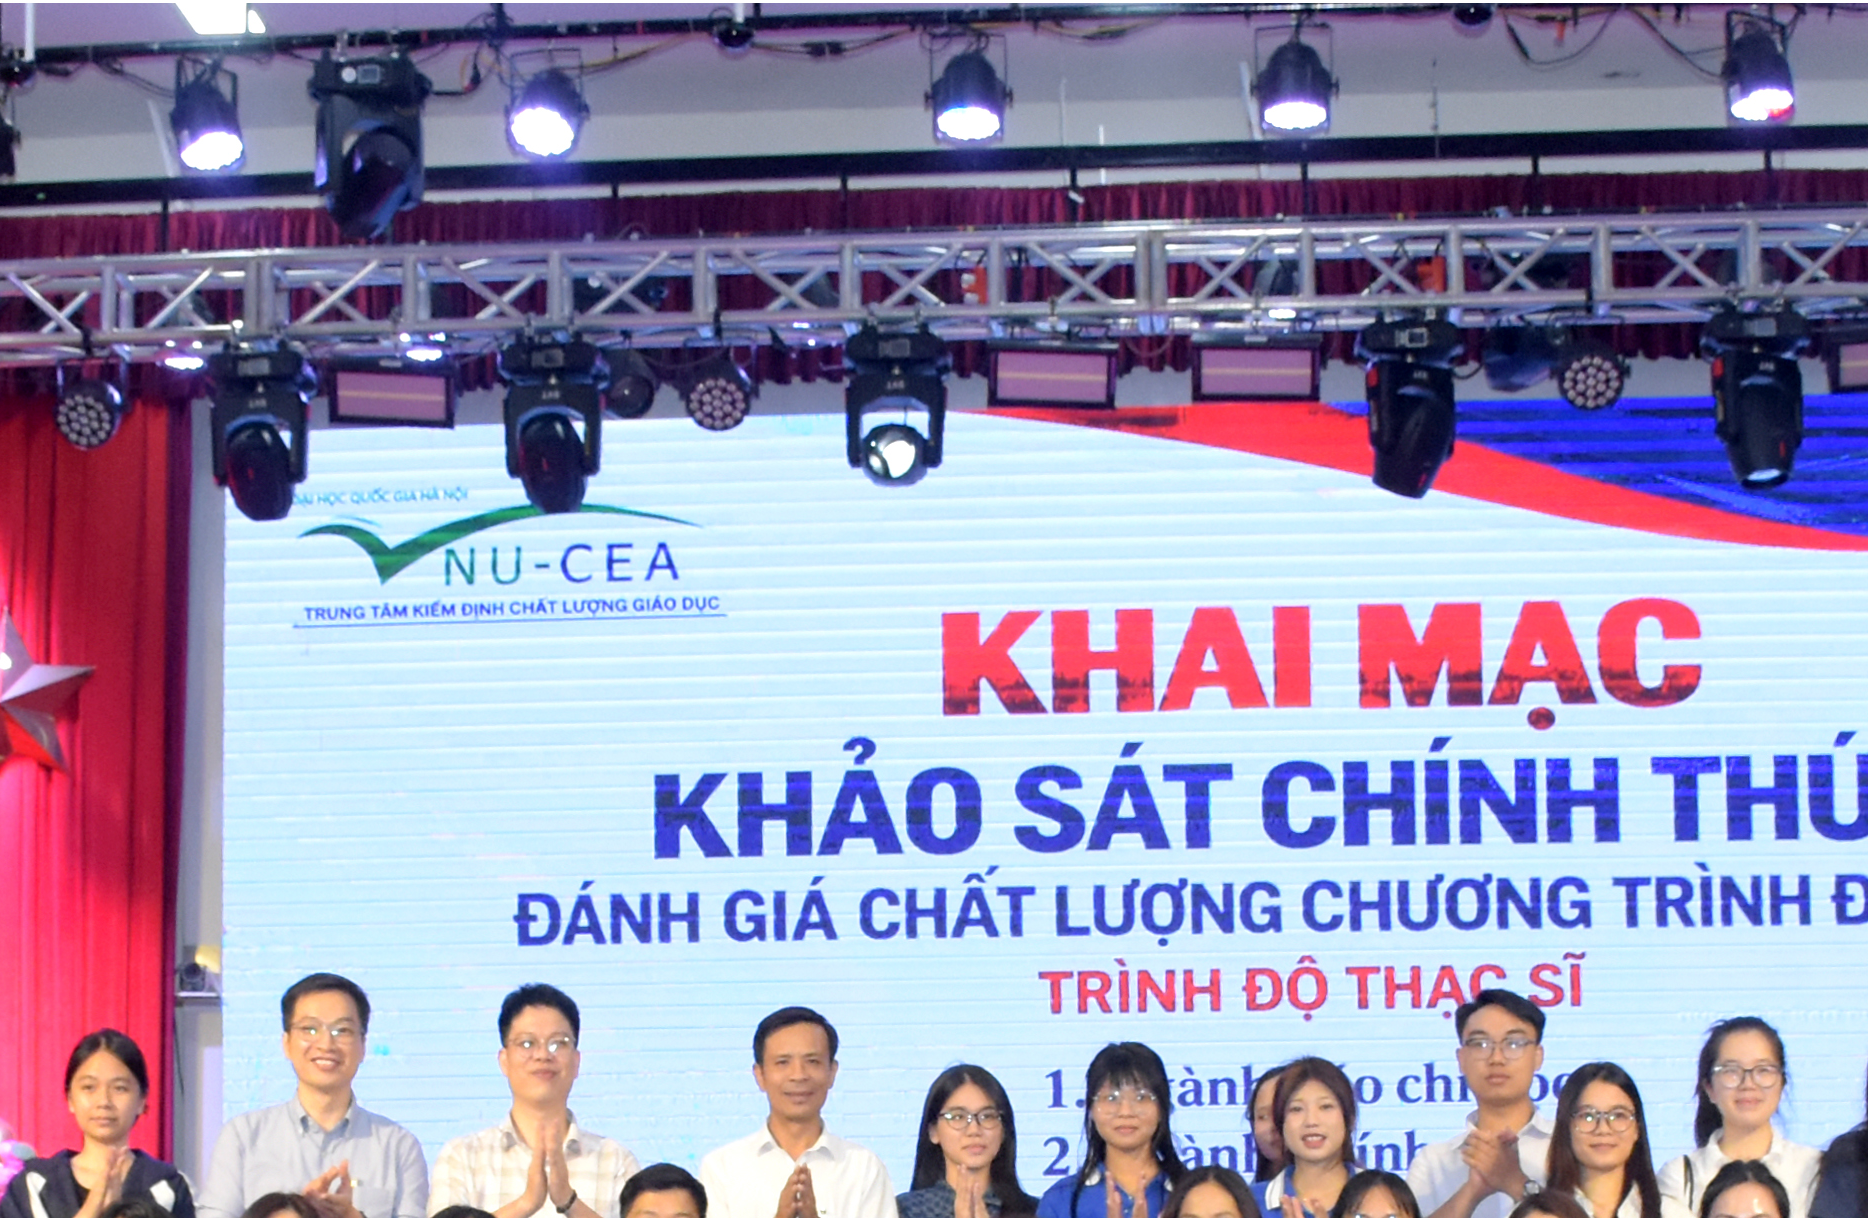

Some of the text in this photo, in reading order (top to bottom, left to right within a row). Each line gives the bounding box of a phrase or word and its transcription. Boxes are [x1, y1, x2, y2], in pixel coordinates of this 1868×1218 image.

[304, 606, 366, 621] TRUNG
[370, 602, 409, 619] TÂM
[461, 601, 505, 621] ĐỊNH
[509, 596, 557, 616] CHẤT
[562, 598, 628, 618] LƯỢNG
[632, 596, 677, 613] GIÁO
[682, 595, 721, 613] DỤC
[940, 596, 1702, 731] KHAI MẠC
[654, 736, 984, 859] KHẢO
[1013, 743, 1232, 853] SÁT
[1261, 736, 1621, 848] CHÍNH
[513, 880, 701, 946] ĐÁNH
[723, 876, 840, 941] GIÁ
[859, 867, 1036, 939] CHẤT
[1056, 878, 1281, 947] LƯỢNG
[1302, 873, 1592, 932] CHƯƠNG
[1613, 863, 1812, 928] TRÌNH
[1039, 951, 1586, 1021] TRÌNH ĐỘ THẠC SĨ
